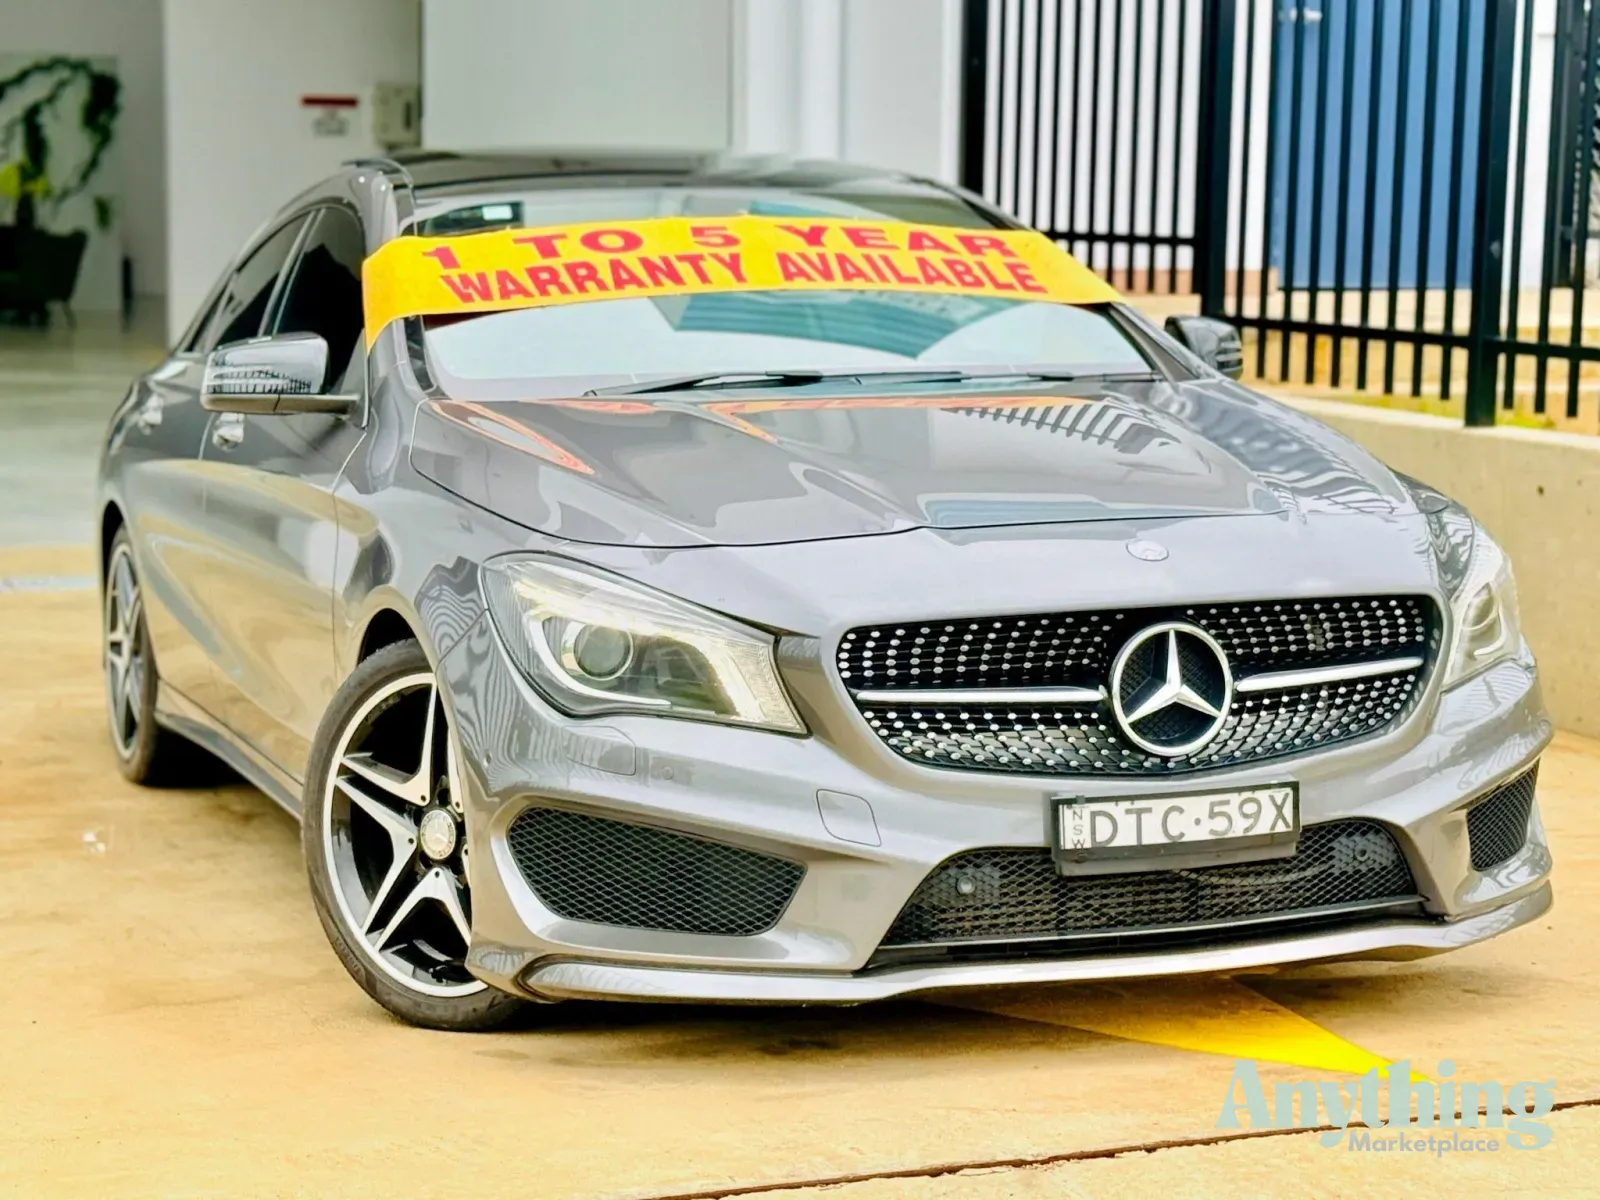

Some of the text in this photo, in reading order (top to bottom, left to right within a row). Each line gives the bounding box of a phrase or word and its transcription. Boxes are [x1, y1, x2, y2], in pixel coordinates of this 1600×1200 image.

[422, 225, 1020, 269] 1 TO 5 YEAR
[440, 252, 1048, 304] WARRANTY AVAILABLE
[1071, 809, 1086, 850] NSW
